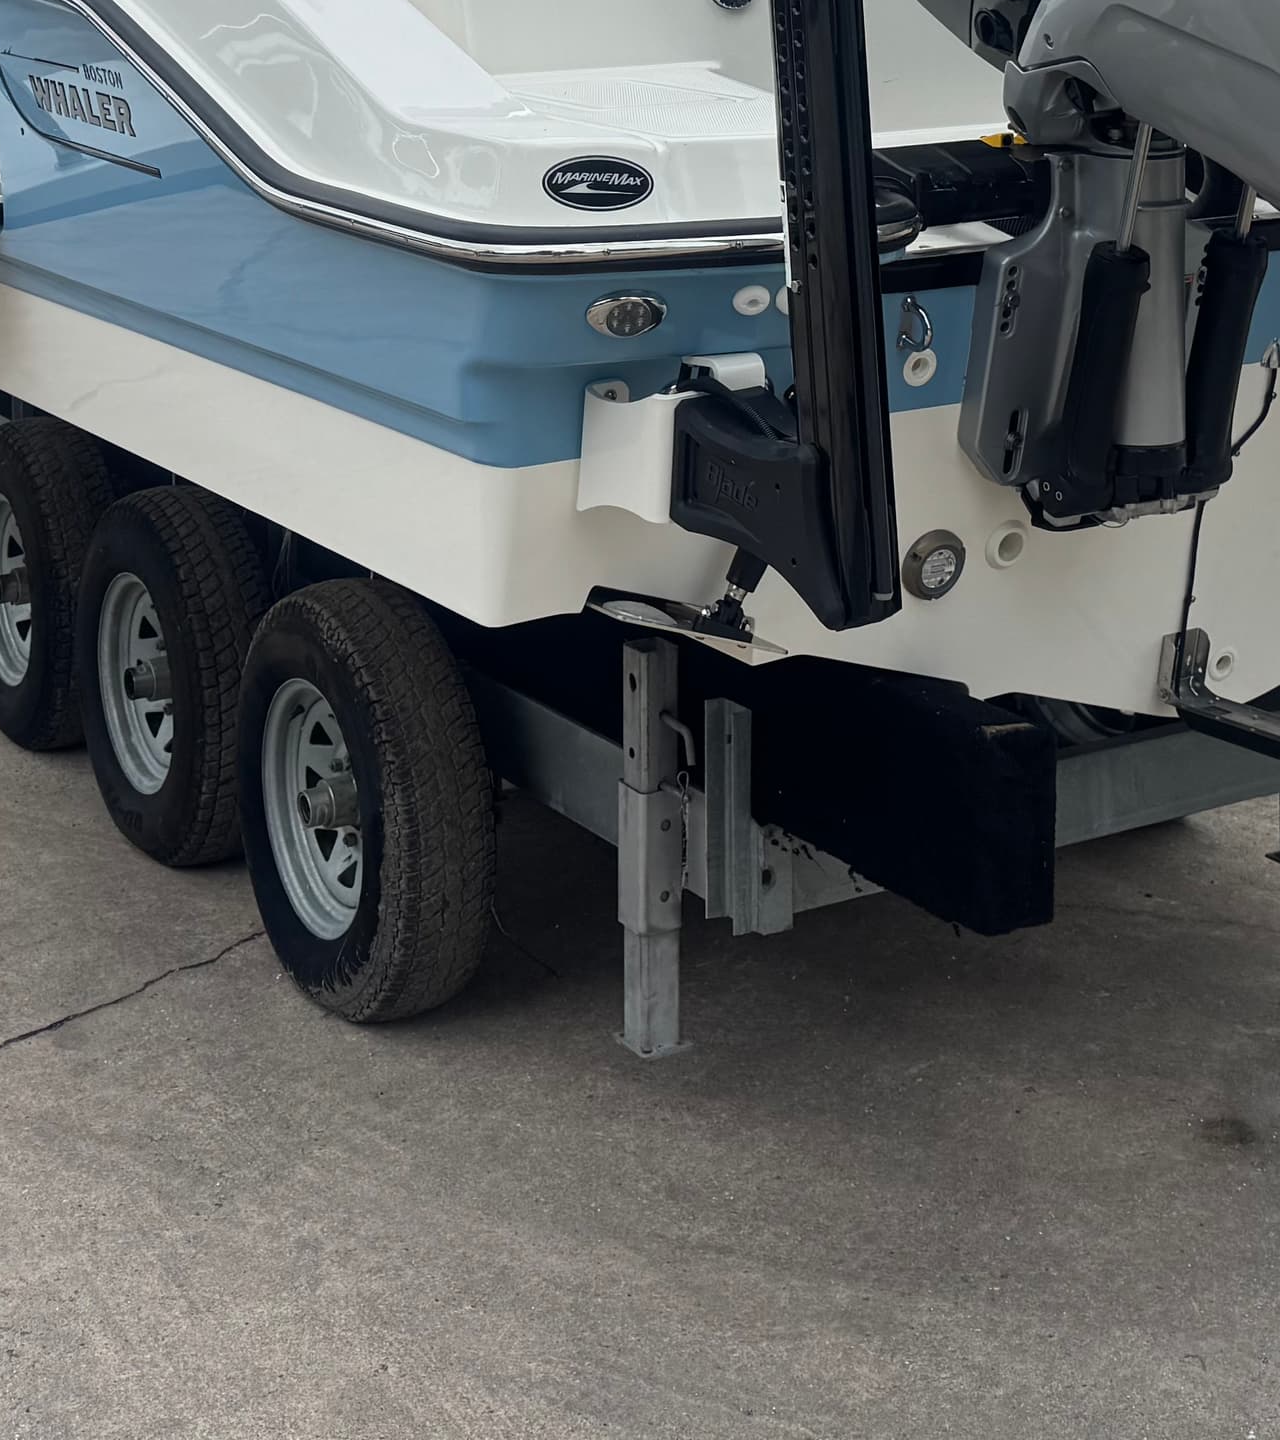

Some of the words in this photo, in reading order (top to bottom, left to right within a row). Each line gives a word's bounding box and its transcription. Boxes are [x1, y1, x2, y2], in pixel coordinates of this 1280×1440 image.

[83, 63, 123, 90] BOSTON
[28, 74, 136, 137] WHALER
[706, 461, 759, 513] Blade
